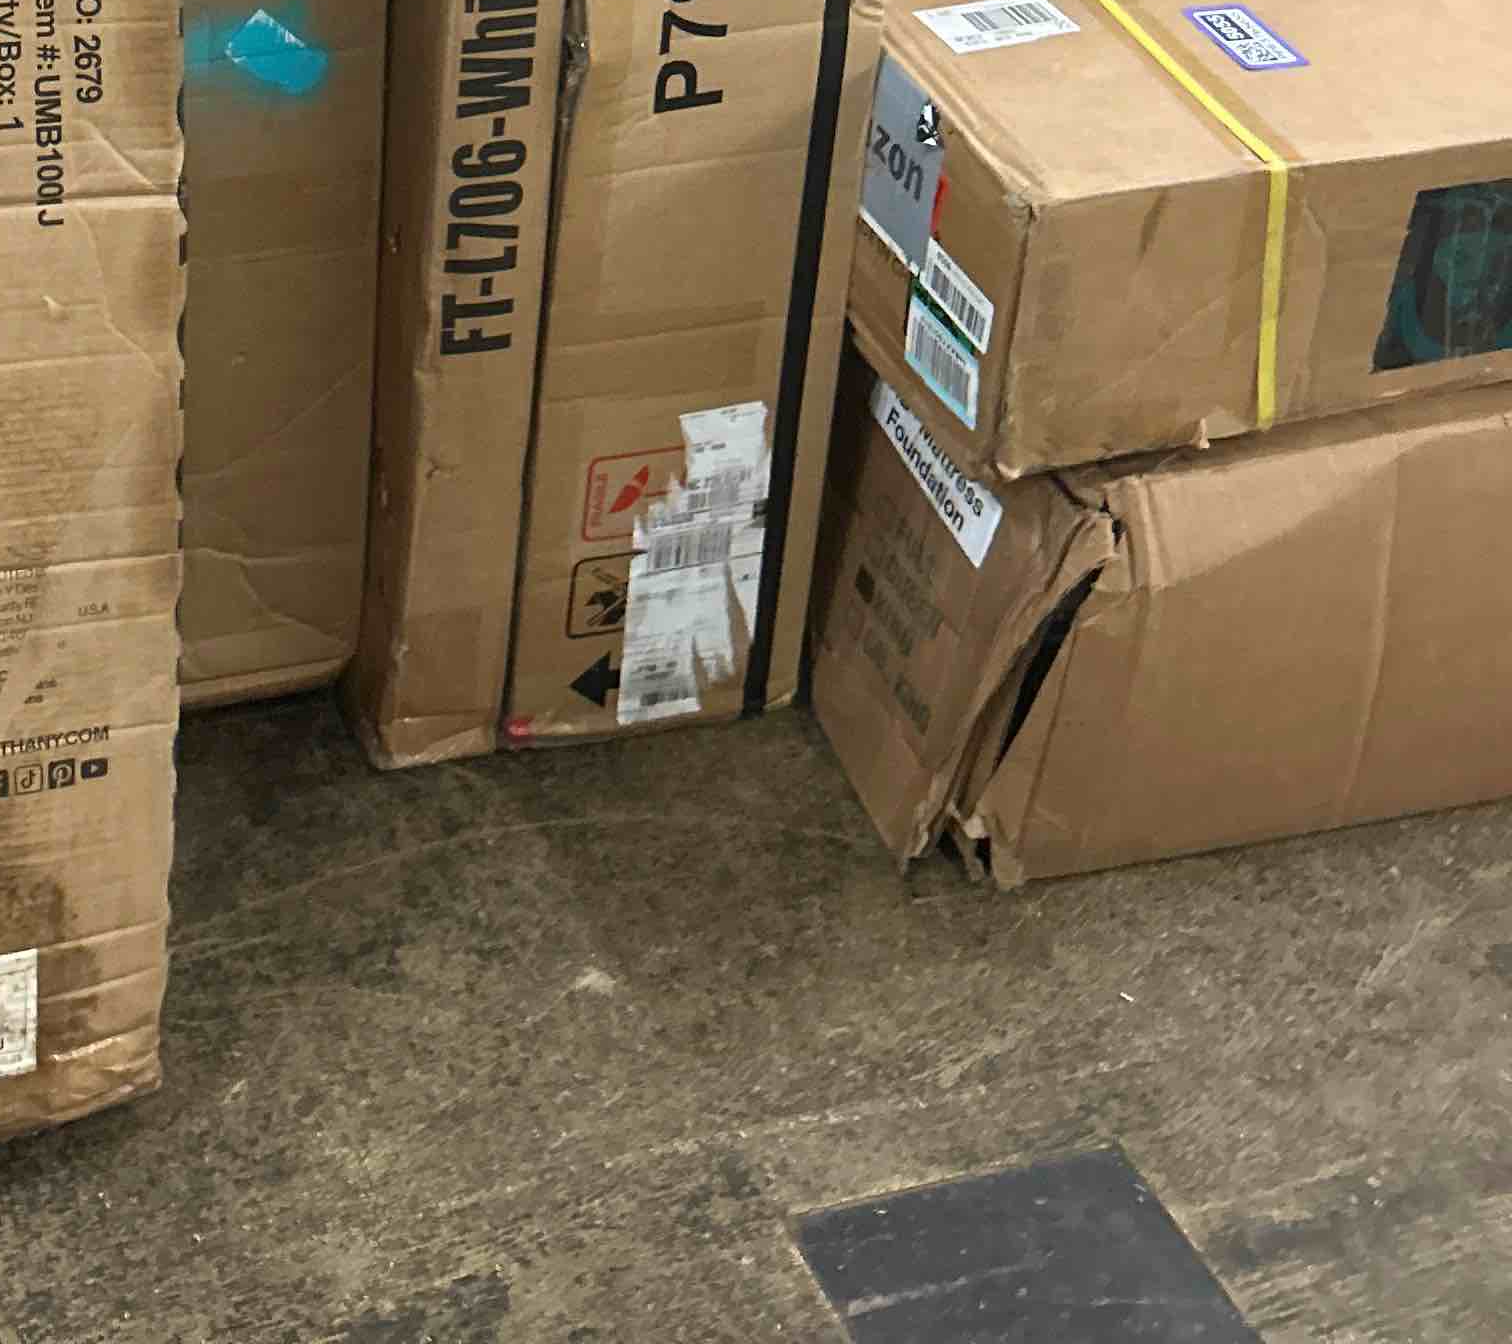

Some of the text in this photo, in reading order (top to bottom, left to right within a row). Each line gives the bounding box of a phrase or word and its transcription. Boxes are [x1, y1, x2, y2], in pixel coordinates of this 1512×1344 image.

[73, 35, 105, 105] 2679
[0, 116, 25, 132] 1
[868, 121, 925, 201] zon
[884, 406, 966, 533] Foundation
